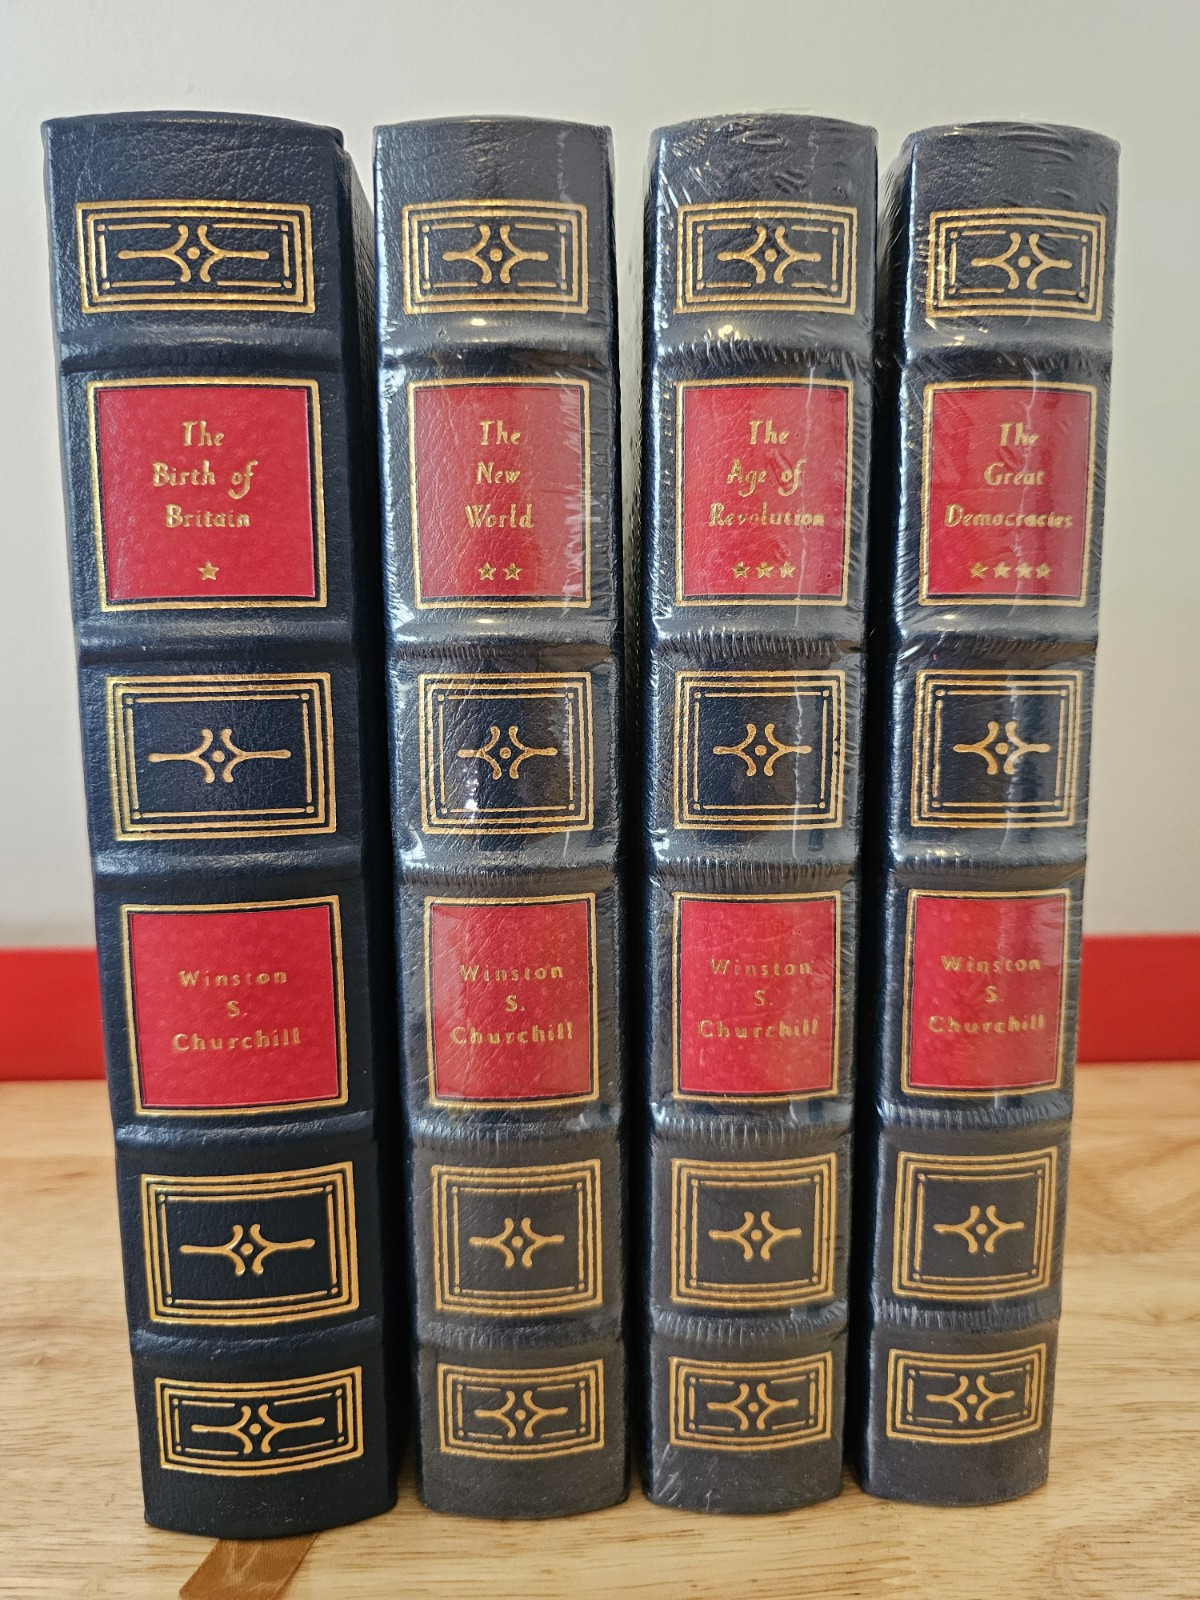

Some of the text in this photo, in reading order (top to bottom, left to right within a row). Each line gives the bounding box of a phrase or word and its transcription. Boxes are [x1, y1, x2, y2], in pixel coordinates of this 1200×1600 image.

[182, 420, 225, 447] The
[479, 419, 521, 446] The
[748, 419, 789, 446] The
[999, 421, 1039, 447] The
[152, 460, 258, 500] Birth of
[476, 462, 521, 485] New
[727, 458, 806, 497] Age of
[984, 463, 1045, 486] Great
[165, 504, 251, 528] Britain
[464, 504, 534, 529] World
[709, 502, 825, 528] Revolution
[944, 503, 1073, 529] Democracies
[459, 963, 565, 982] Winston
[710, 957, 813, 976] Winston
[940, 954, 1042, 973] Winston
[178, 969, 288, 987] Winston
[227, 1000, 249, 1018] S.
[505, 995, 526, 1013] S.
[450, 1022, 574, 1044] Churchill
[698, 1017, 820, 1038] Churchill
[928, 1014, 1045, 1034] Churchill
[172, 1027, 302, 1051] Churchill
